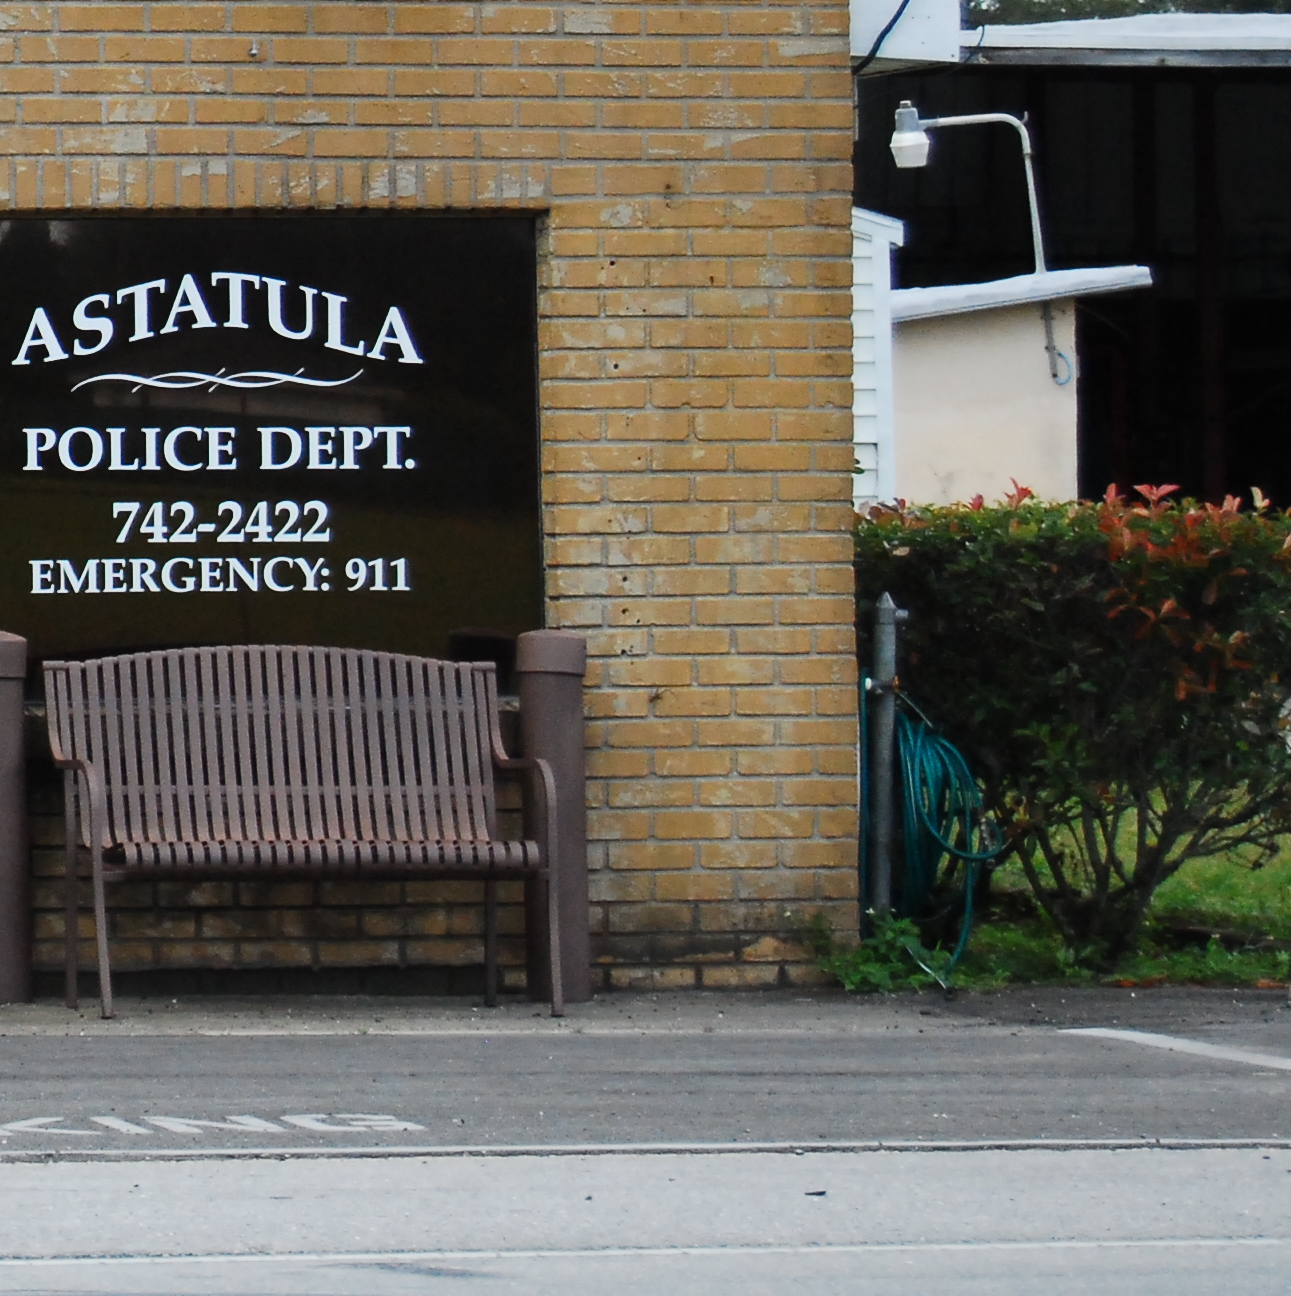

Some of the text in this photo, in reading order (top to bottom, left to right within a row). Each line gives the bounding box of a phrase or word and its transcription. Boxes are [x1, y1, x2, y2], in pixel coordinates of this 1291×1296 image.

[11, 271, 423, 366] ASTATULA
[22, 426, 416, 472] POLICE DEPT.
[112, 500, 331, 544] 742-2422
[29, 557, 411, 594] EMERGENCY: 911
